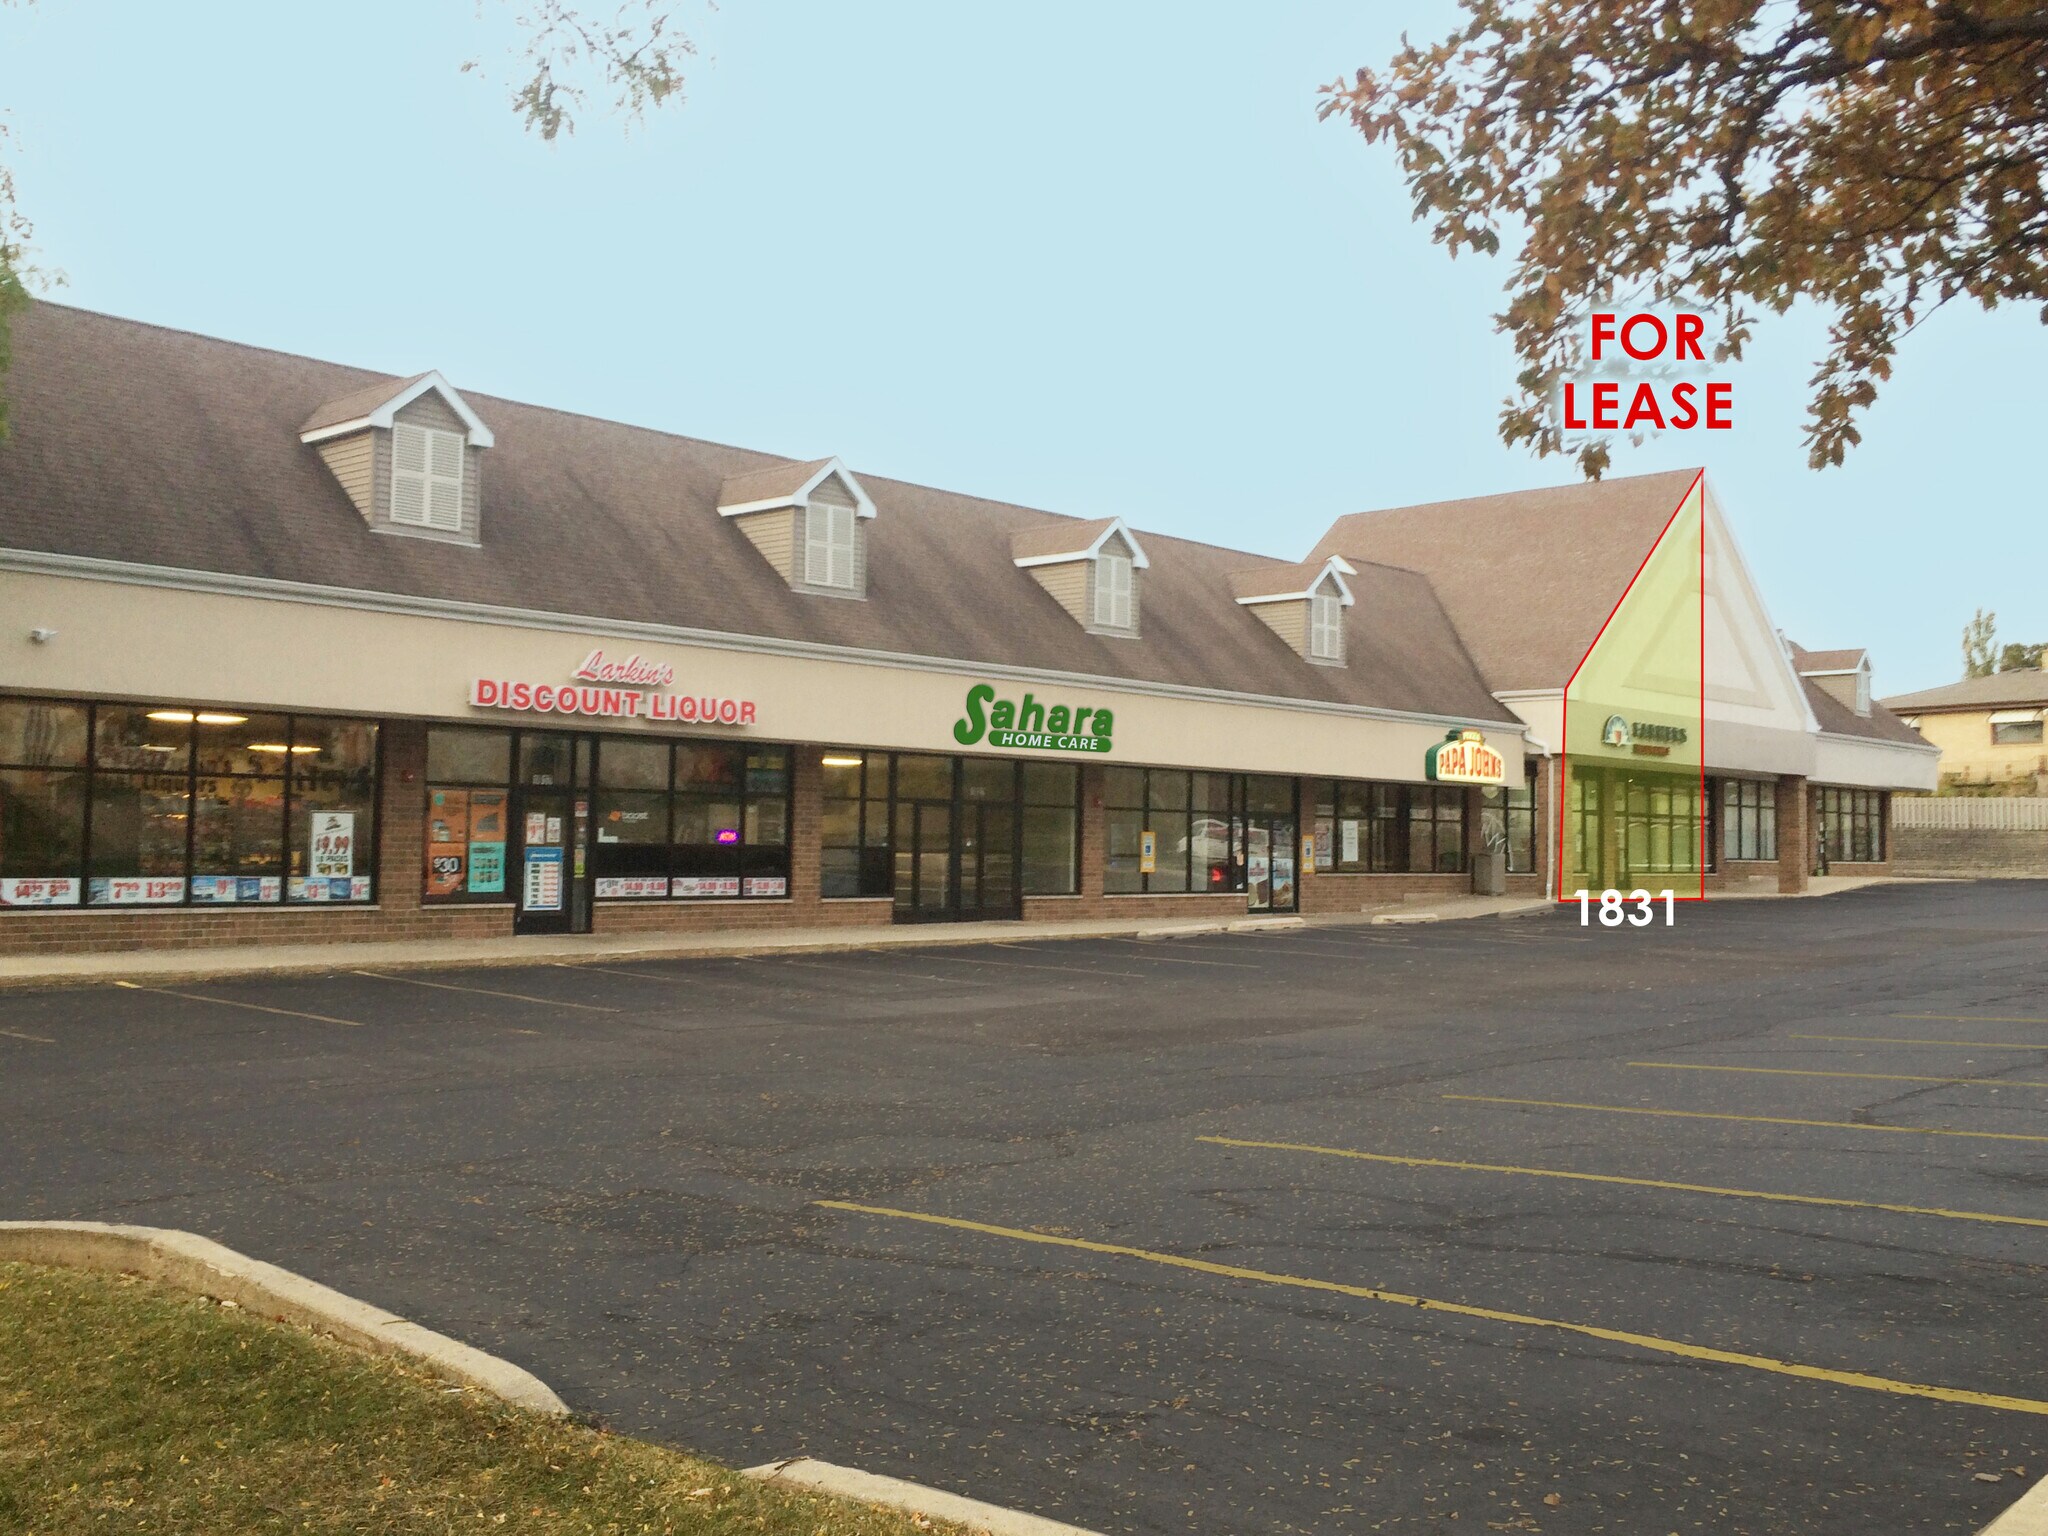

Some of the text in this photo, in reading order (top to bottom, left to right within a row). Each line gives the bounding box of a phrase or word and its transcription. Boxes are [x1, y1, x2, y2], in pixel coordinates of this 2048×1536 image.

[576, 650, 675, 686] Larkin's
[477, 679, 756, 724] DISCOUNT LIQUOR
[953, 684, 1113, 745] Sahara
[1001, 733, 1099, 750] HOME CARE
[1439, 747, 1467, 775] PAPA
